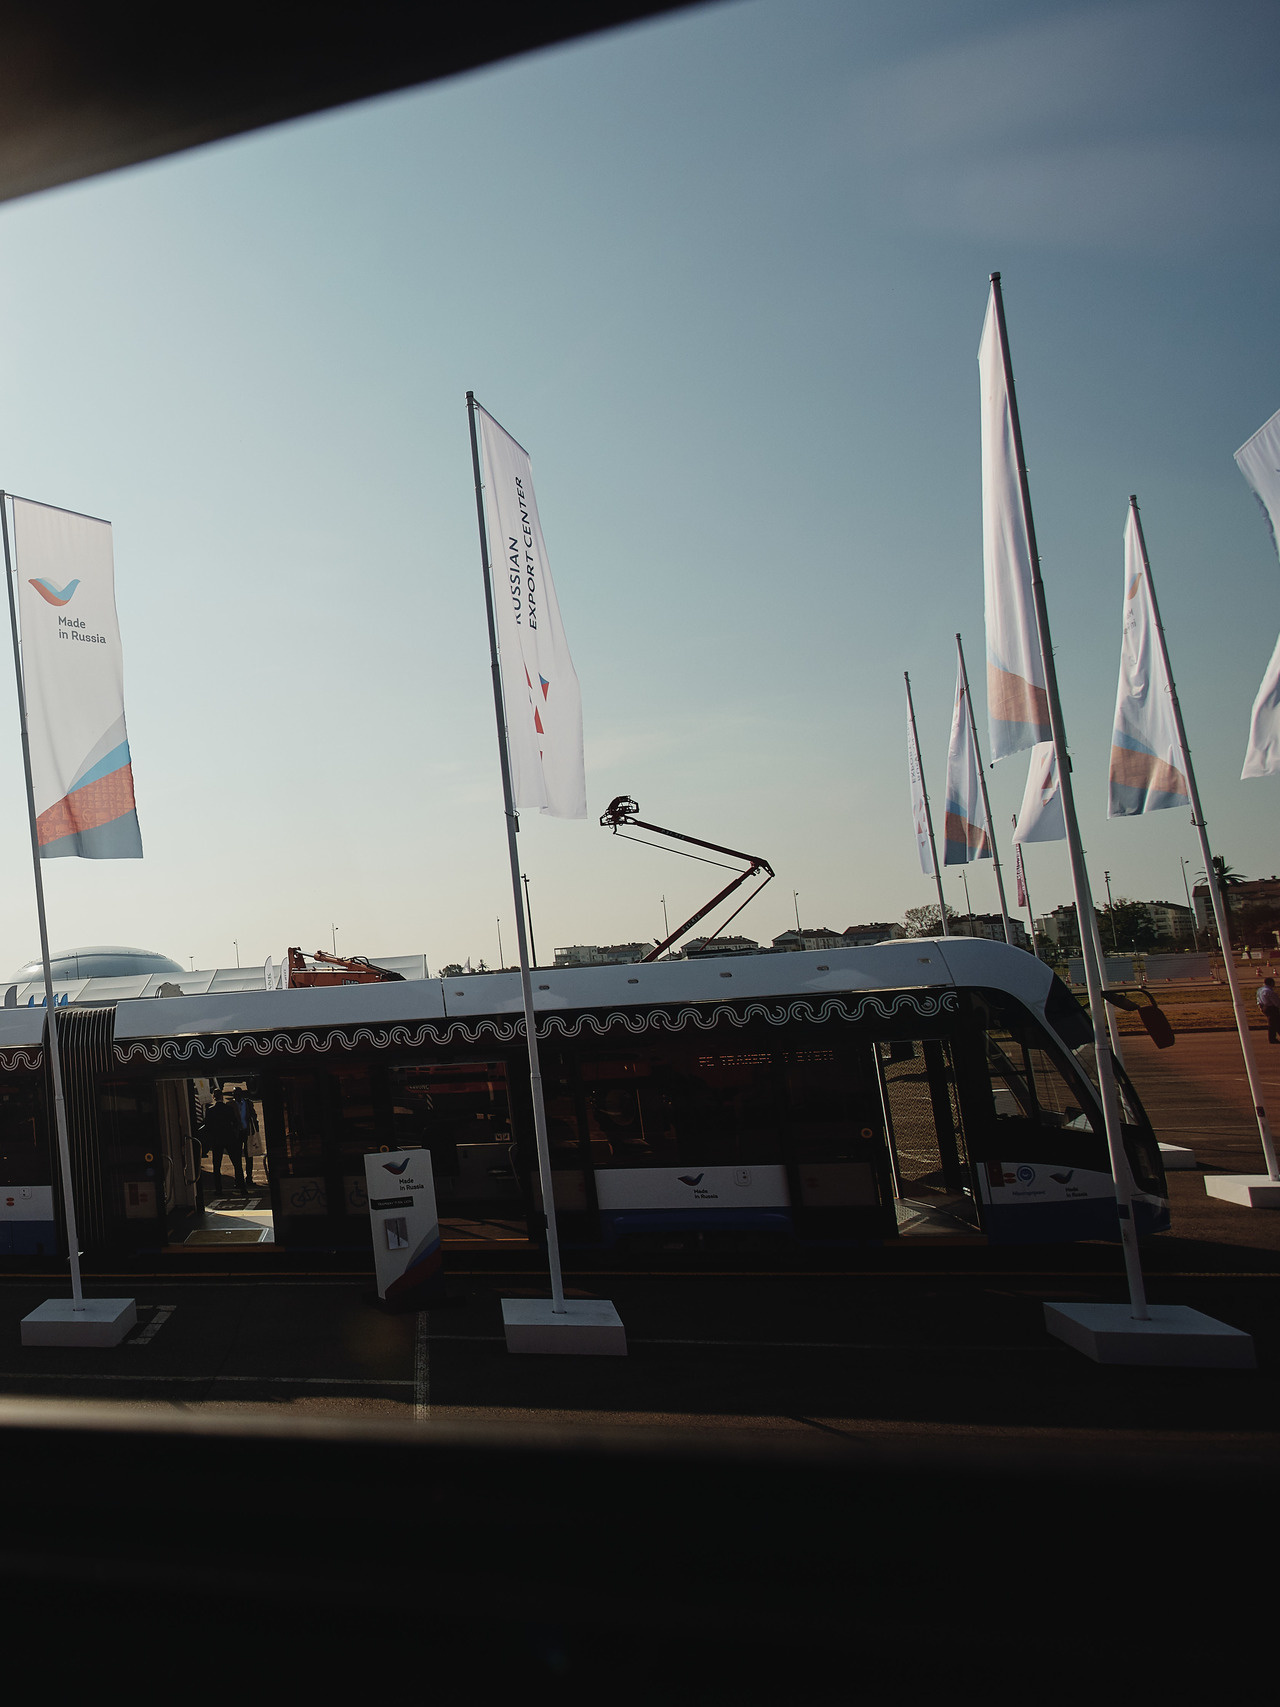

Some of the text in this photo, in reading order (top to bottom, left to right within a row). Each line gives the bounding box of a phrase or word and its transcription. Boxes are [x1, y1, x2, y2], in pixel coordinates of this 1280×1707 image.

[515, 476, 537, 630] EXPORT CENTER
[58, 616, 86, 629] Made
[58, 629, 107, 644] in Russia
